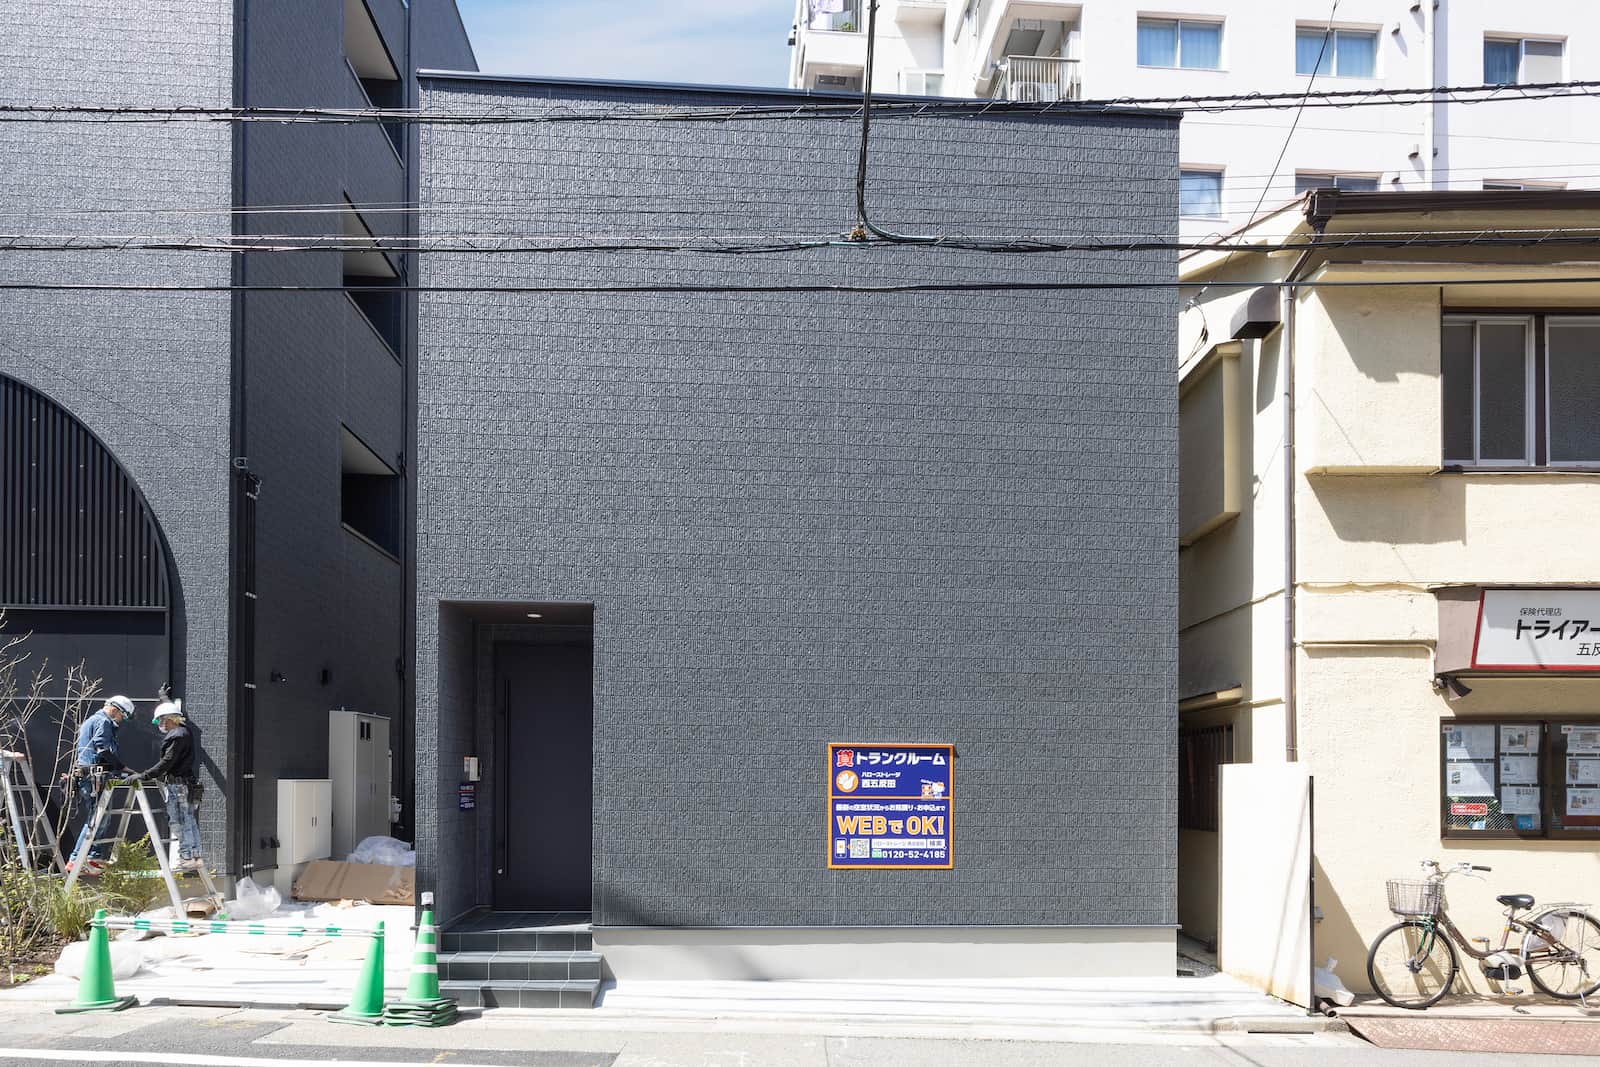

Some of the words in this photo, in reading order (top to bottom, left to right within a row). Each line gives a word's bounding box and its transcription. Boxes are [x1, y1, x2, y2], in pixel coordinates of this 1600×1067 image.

[1520, 607, 1562, 617] 保険代理店
[857, 752, 945, 765] トランクルーム
